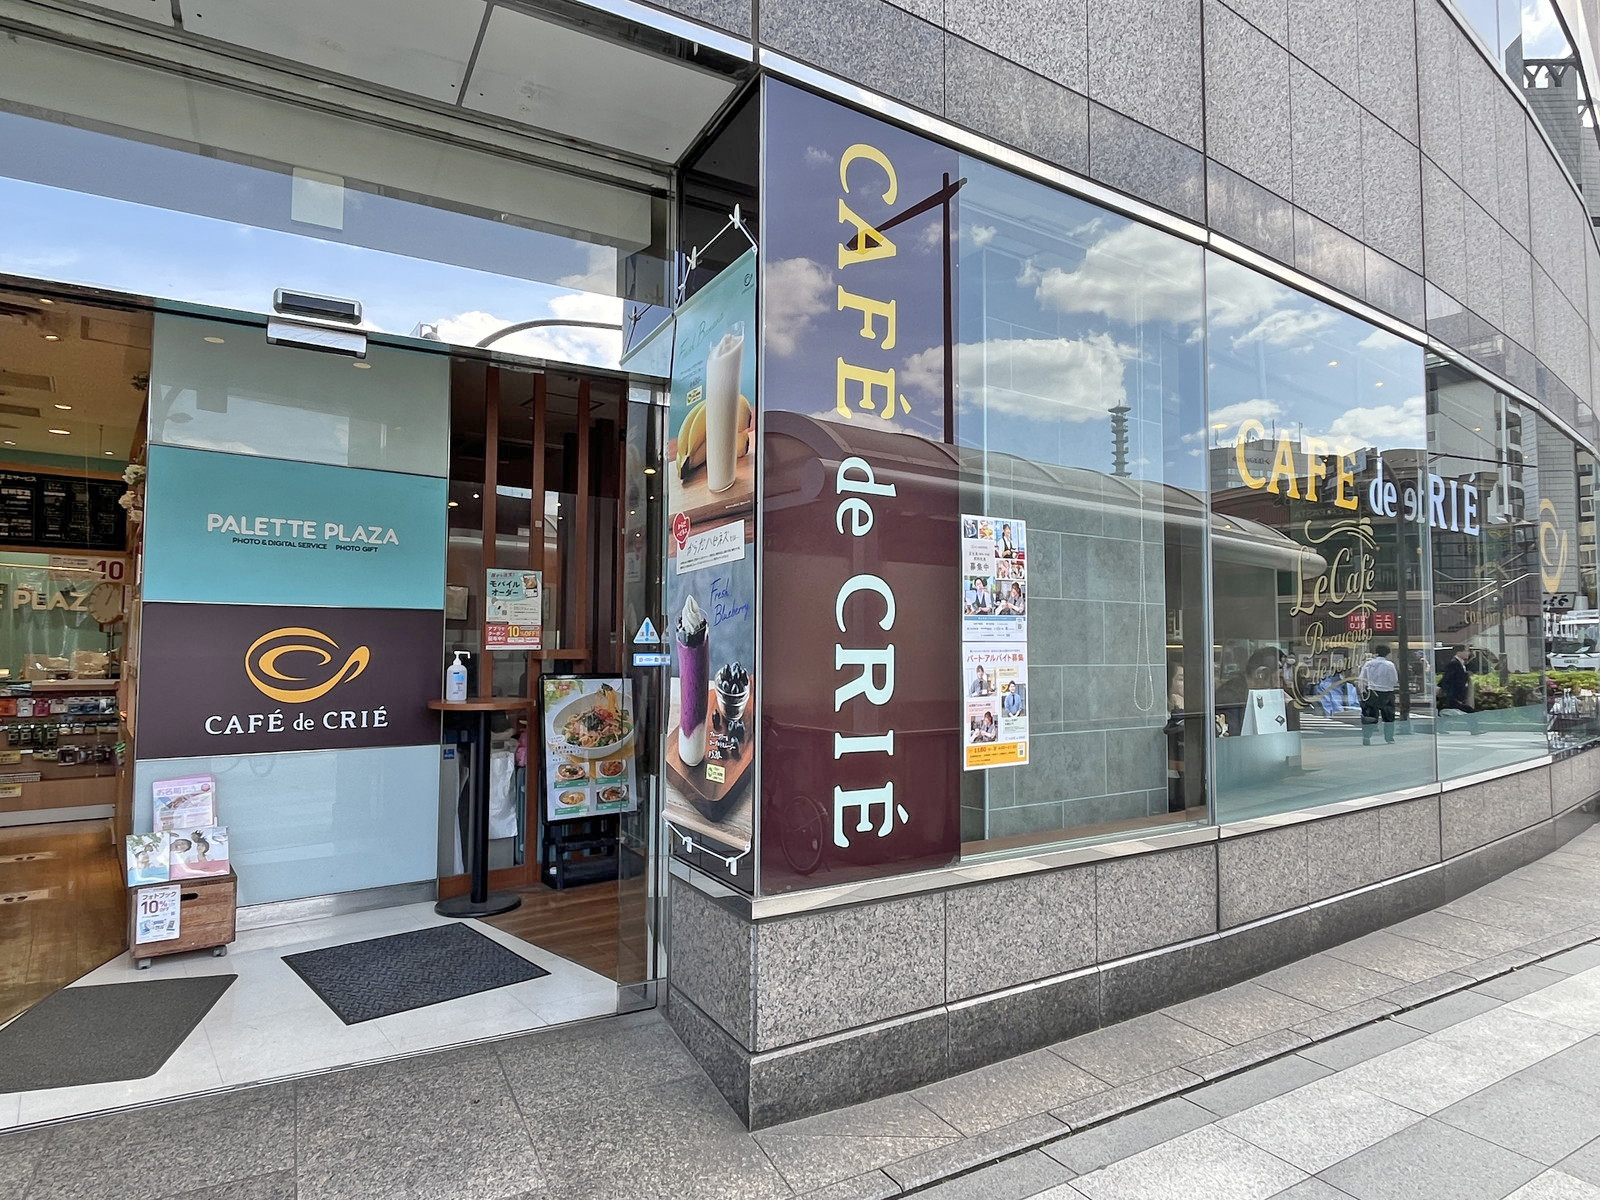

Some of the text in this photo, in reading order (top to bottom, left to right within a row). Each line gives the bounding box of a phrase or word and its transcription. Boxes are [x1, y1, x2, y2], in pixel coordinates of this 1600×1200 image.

[833, 143, 912, 849] CAFÉ de CRIÉ
[1369, 456, 1398, 518] de
[1428, 472, 1480, 537] RIÉ
[207, 513, 399, 546] PALETTE PLAZA
[232, 537, 261, 545] PHOTO
[268, 540, 297, 548] DIGITAL
[298, 542, 328, 550] SERVICE
[335, 544, 361, 552] PHOTO
[96, 560, 124, 580] 10
[490, 580, 520, 588] モバイル
[1289, 545, 1375, 616] Le Café
[13, 590, 89, 611] PLAZ
[710, 577, 730, 607] Fresh
[713, 599, 749, 627] Blueberry
[507, 625, 520, 637] 10
[1304, 620, 1373, 659] Beaucoup
[204, 706, 389, 735] CAFÉ de CRIÉ
[141, 891, 177, 901] フォトブック
